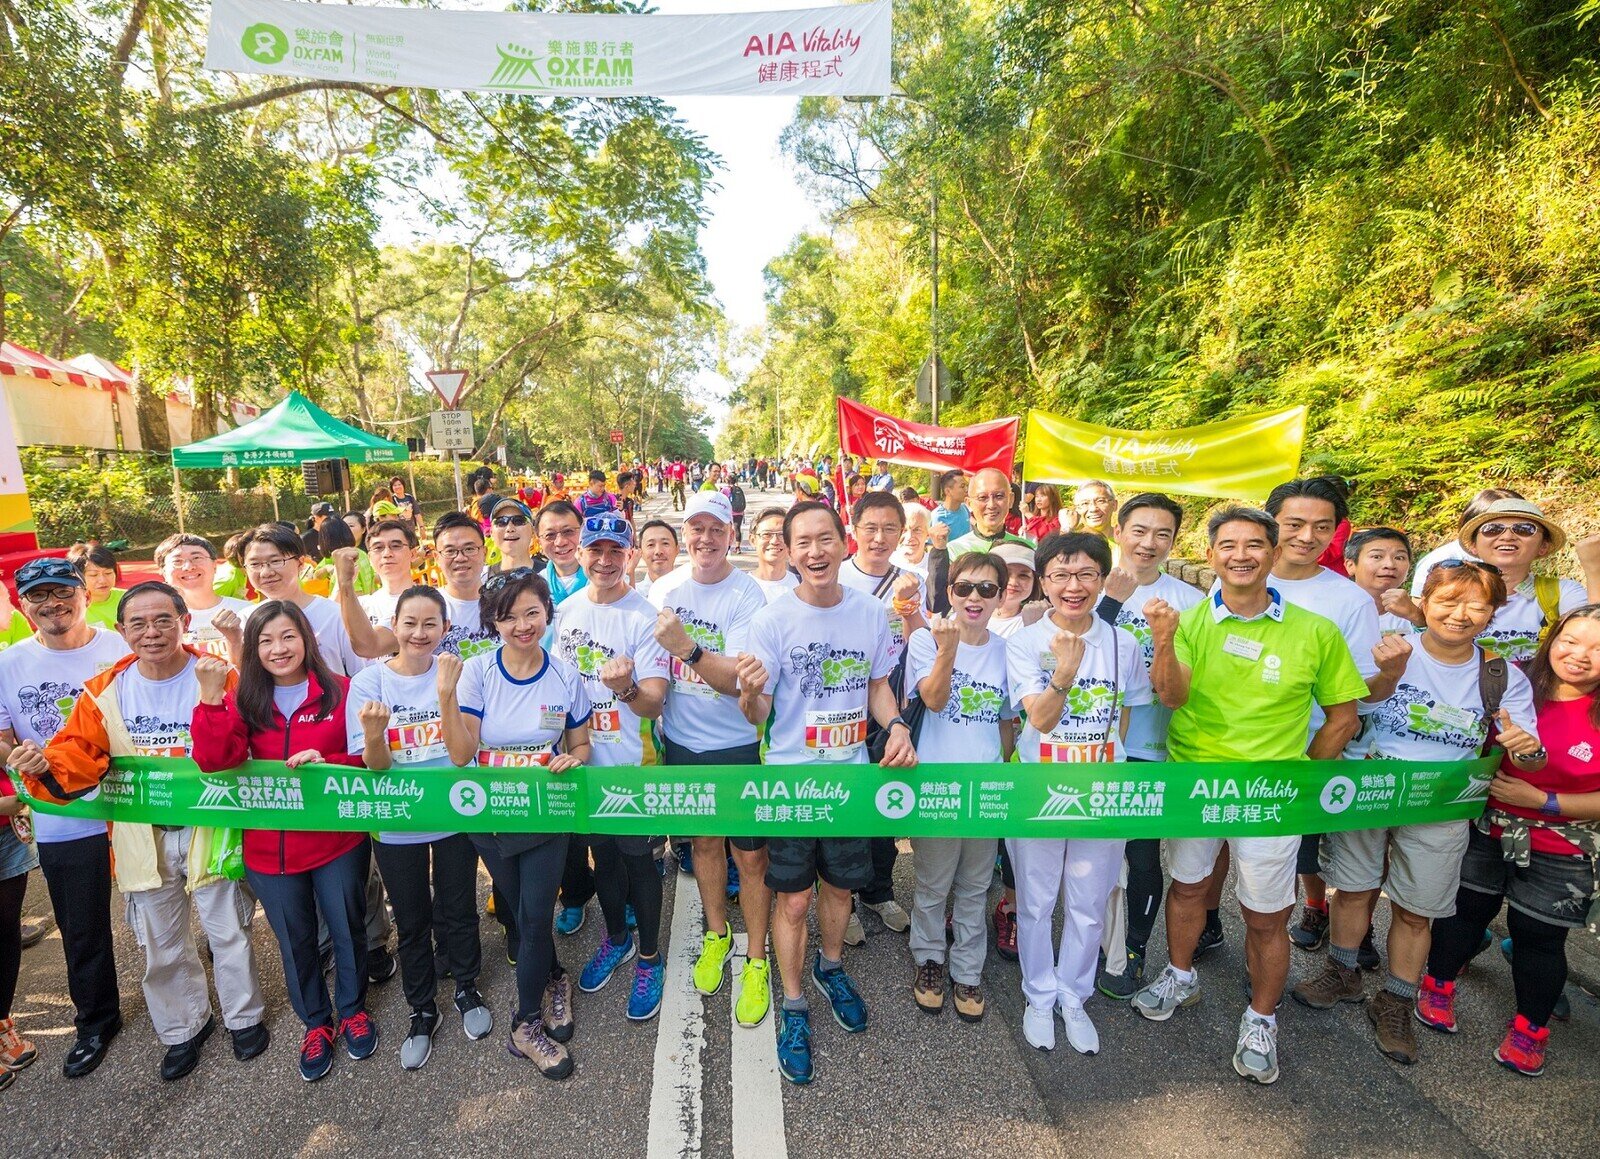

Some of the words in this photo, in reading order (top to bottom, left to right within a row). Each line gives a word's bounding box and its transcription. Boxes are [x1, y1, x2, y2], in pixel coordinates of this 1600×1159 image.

[294, 28, 343, 46] 樂施會
[743, 32, 798, 57] AIA
[803, 26, 861, 56] Vitality
[547, 39, 634, 56] 樂施毅行者
[294, 45, 343, 64] OXFAM
[366, 50, 391, 60] World
[317, 63, 340, 74] Kong
[365, 59, 400, 71] Without
[547, 57, 633, 77] OXFAM
[758, 56, 843, 84] 健康程式
[366, 68, 397, 79] Poverty
[548, 77, 633, 87] TRAILWALKER
[875, 437, 905, 453] AIA
[1091, 435, 1139, 455] AIA
[1141, 436, 1198, 461] Vitality
[1102, 457, 1181, 477] 健康程式
[298, 714, 315, 723] AIA
[152, 736, 178, 744] 2017
[816, 723, 860, 748] L001
[237, 776, 302, 788] 樂施毅行者
[323, 776, 369, 795] AIA
[372, 775, 424, 802] Vitality
[490, 781, 529, 794] 樂施會
[644, 783, 716, 793] 樂施毅行者
[920, 782, 962, 795] 樂施會
[1091, 781, 1166, 793] 樂施毅行者
[102, 783, 134, 796] OXFAM
[238, 786, 304, 801] OXFAM
[740, 781, 790, 799] AIA
[794, 778, 850, 805] Vitality
[1190, 779, 1240, 798] AIA
[1245, 776, 1298, 803] Vitality
[1357, 789, 1395, 802] OXFAM
[242, 801, 304, 810] TRAILWALKER
[490, 795, 530, 808] OXFAM
[643, 793, 716, 807] OXFAM
[918, 797, 961, 810] OXFAM
[980, 802, 1008, 810] Without
[1089, 793, 1164, 807] OXFAM
[337, 799, 412, 819] 健康程式
[492, 809, 509, 817] Hong
[511, 809, 528, 817] Kong
[548, 809, 576, 818] Poverty
[645, 807, 716, 816] TRAILWALKER
[754, 804, 834, 823] 健康程式
[1090, 807, 1163, 816] TRAILWALKER
[1201, 804, 1281, 823] 健康程式
[1356, 803, 1372, 811] Hong
[919, 811, 938, 820] Hong
[939, 811, 958, 820] Kong
[980, 811, 1008, 820] Poverty
